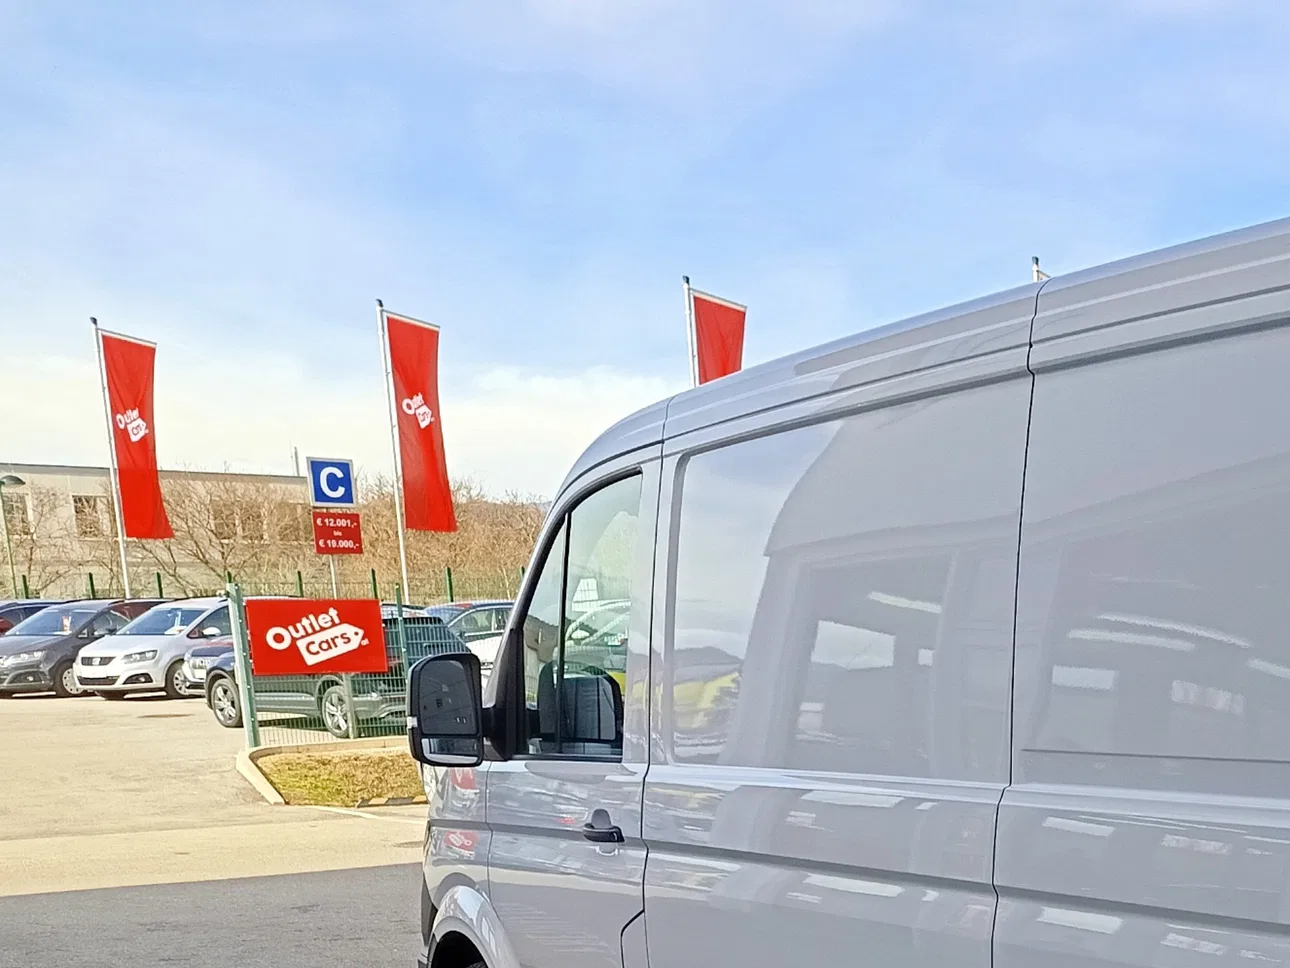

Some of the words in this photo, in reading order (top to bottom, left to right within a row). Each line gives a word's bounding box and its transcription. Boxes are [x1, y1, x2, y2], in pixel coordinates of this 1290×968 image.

[320, 466, 345, 498] C
[265, 606, 340, 650] Outlet
[305, 631, 351, 655] Cars
